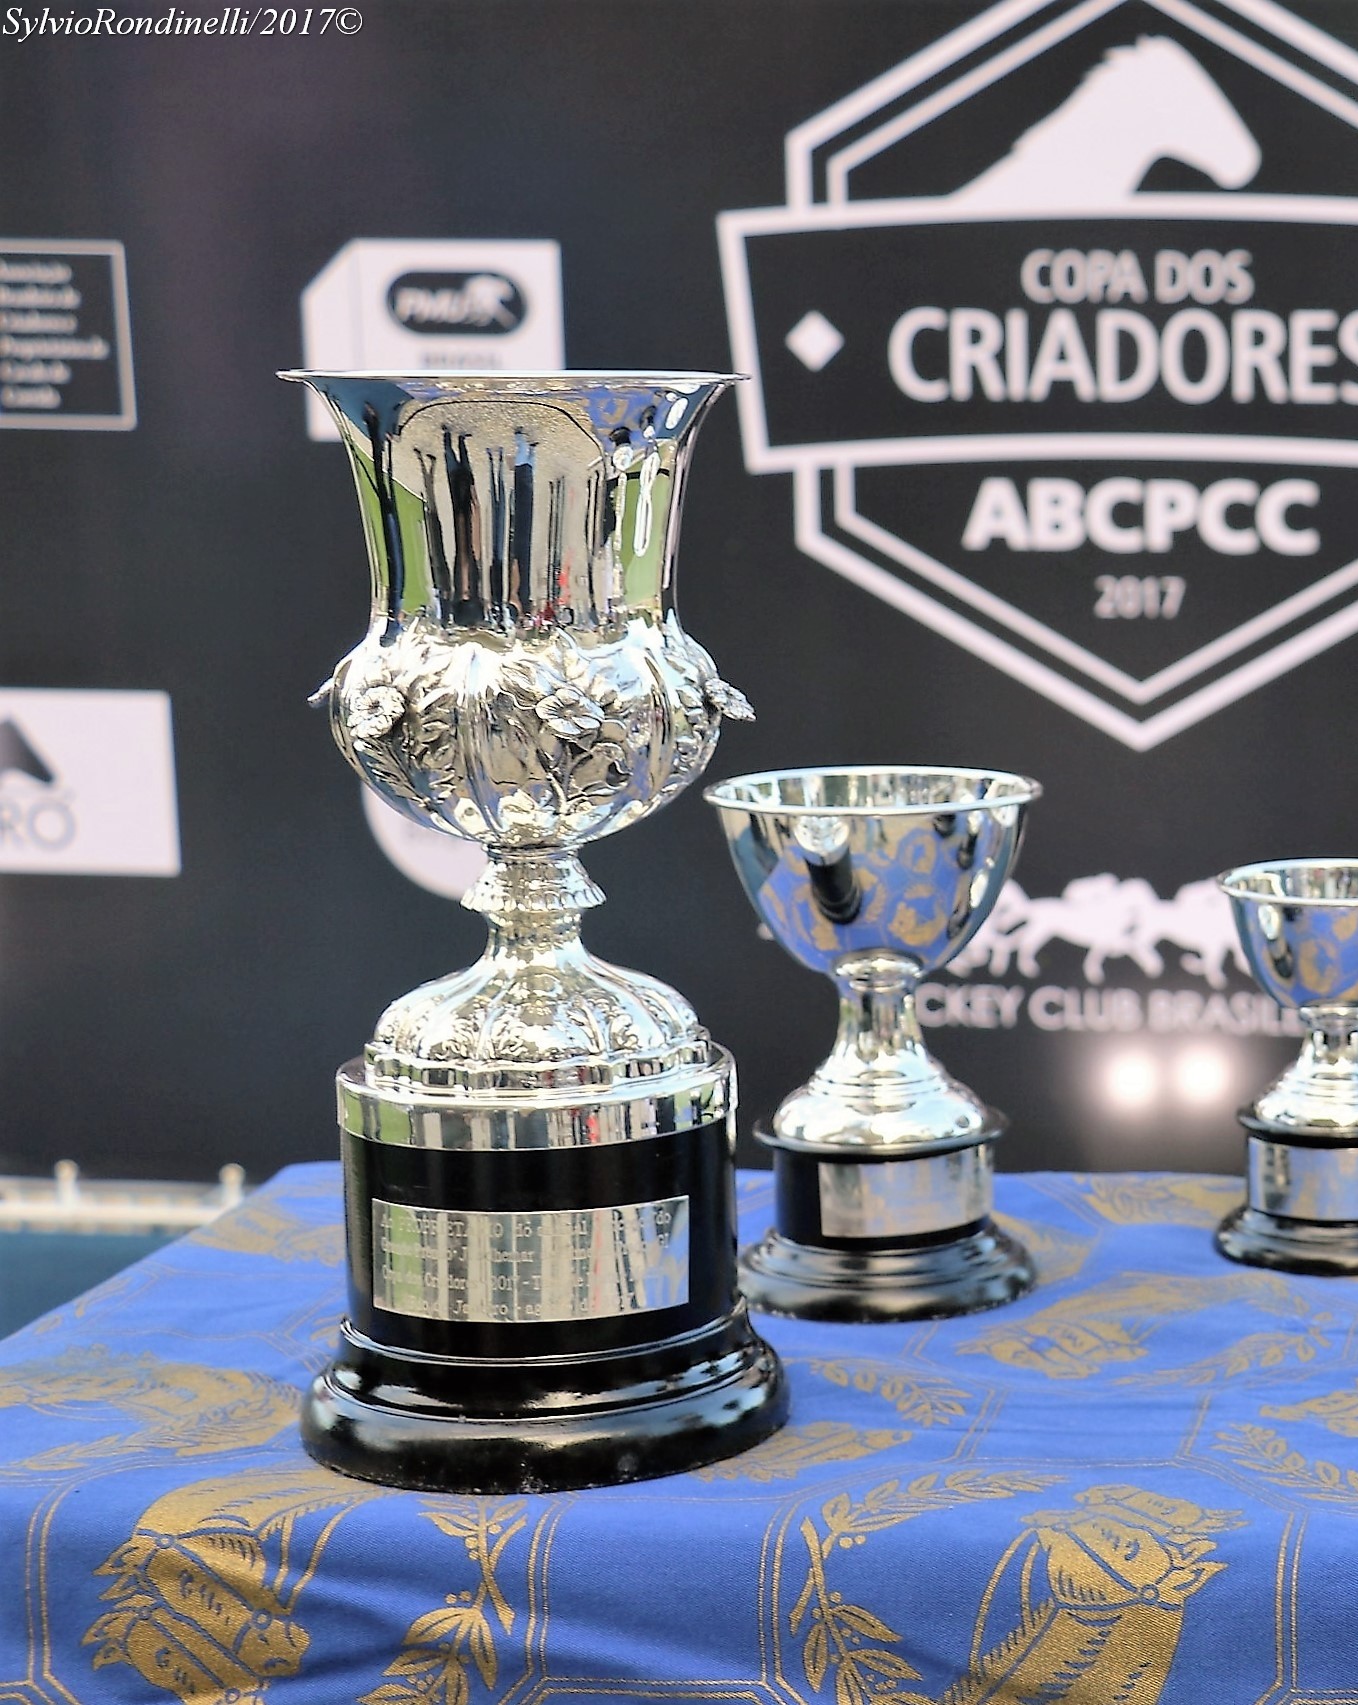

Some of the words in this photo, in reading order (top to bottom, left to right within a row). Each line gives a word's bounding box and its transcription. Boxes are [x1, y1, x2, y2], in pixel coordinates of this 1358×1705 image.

[1020, 248, 1149, 304] COPA
[1154, 248, 1256, 305] DOS
[960, 476, 1322, 557] ABCPCC
[1092, 573, 1188, 620] 2017
[915, 981, 1025, 1028] CKEY
[1028, 984, 1143, 1032] CLUB
